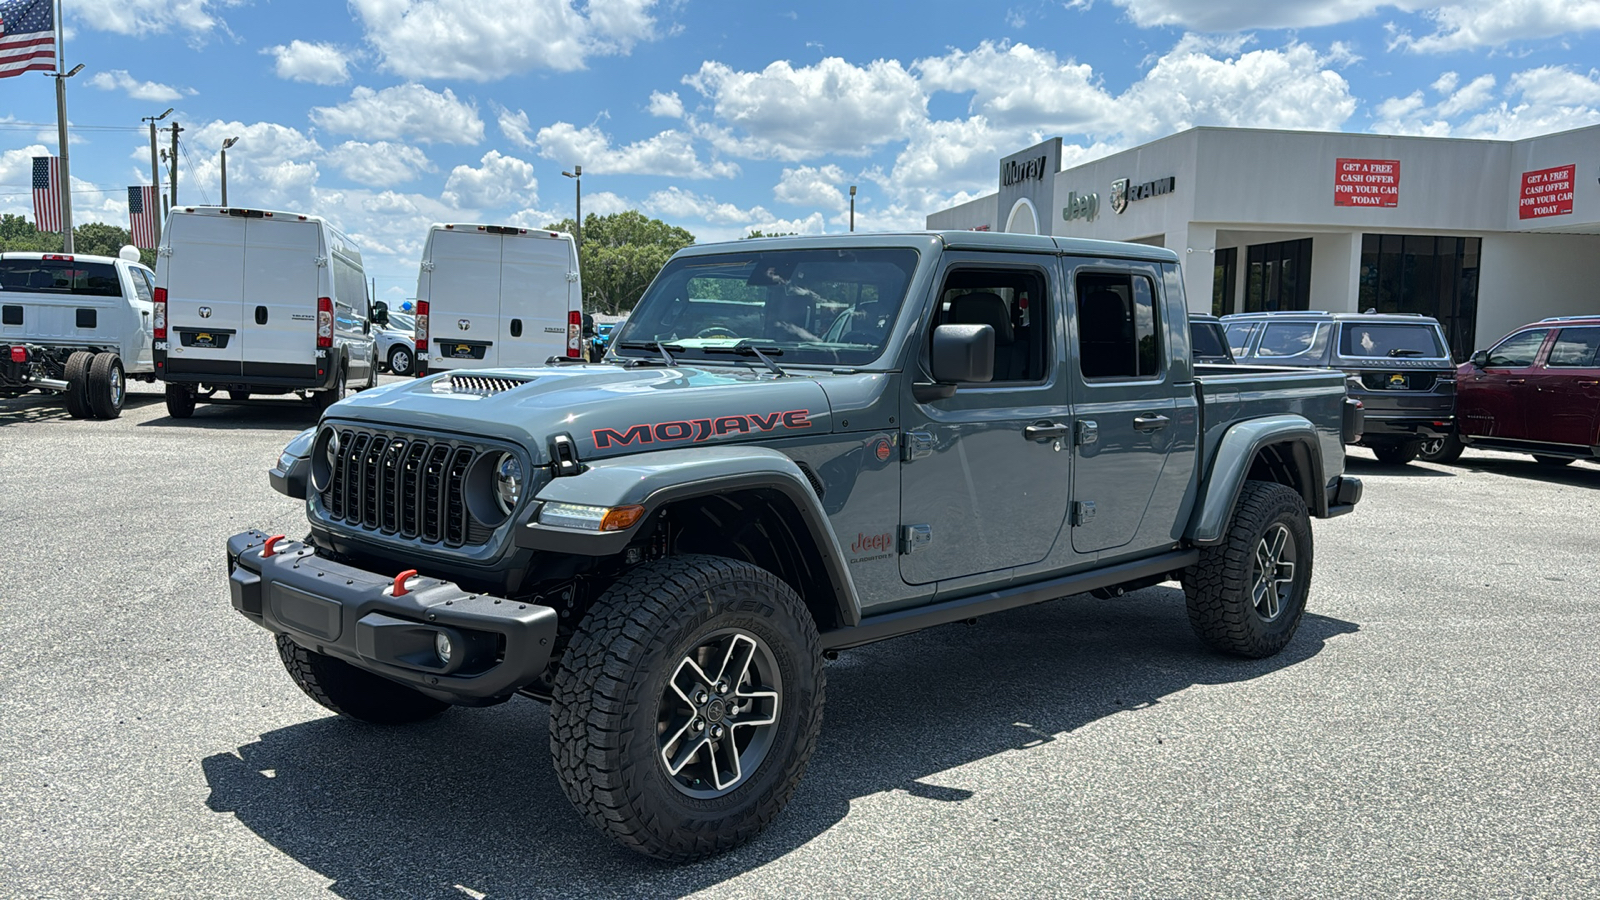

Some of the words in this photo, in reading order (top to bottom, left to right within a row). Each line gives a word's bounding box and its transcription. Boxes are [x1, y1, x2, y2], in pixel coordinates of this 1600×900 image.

[1002, 156, 1046, 187] Murray
[1343, 163, 1361, 171] GET
[1370, 164, 1393, 173] FREE
[1341, 174, 1364, 182] CASH
[1366, 175, 1394, 183] OFFER
[1528, 175, 1542, 184] GET
[1550, 170, 1568, 181] FREE
[1128, 177, 1175, 201] RAM
[1336, 185, 1353, 193] FOR
[1355, 186, 1378, 194] YOUR
[1526, 185, 1544, 195] CASH
[1545, 182, 1569, 192] OFFER
[1352, 196, 1381, 204] TODAY
[1520, 198, 1535, 206] FOR
[1536, 195, 1556, 204] YOUR
[1558, 192, 1573, 201] CAR
[1062, 191, 1100, 222] Jeep
[1533, 205, 1558, 215] TODAY
[591, 409, 812, 449] MOJAVE
[852, 532, 892, 554] Jeep
[850, 554, 887, 564] GLADIATOR
